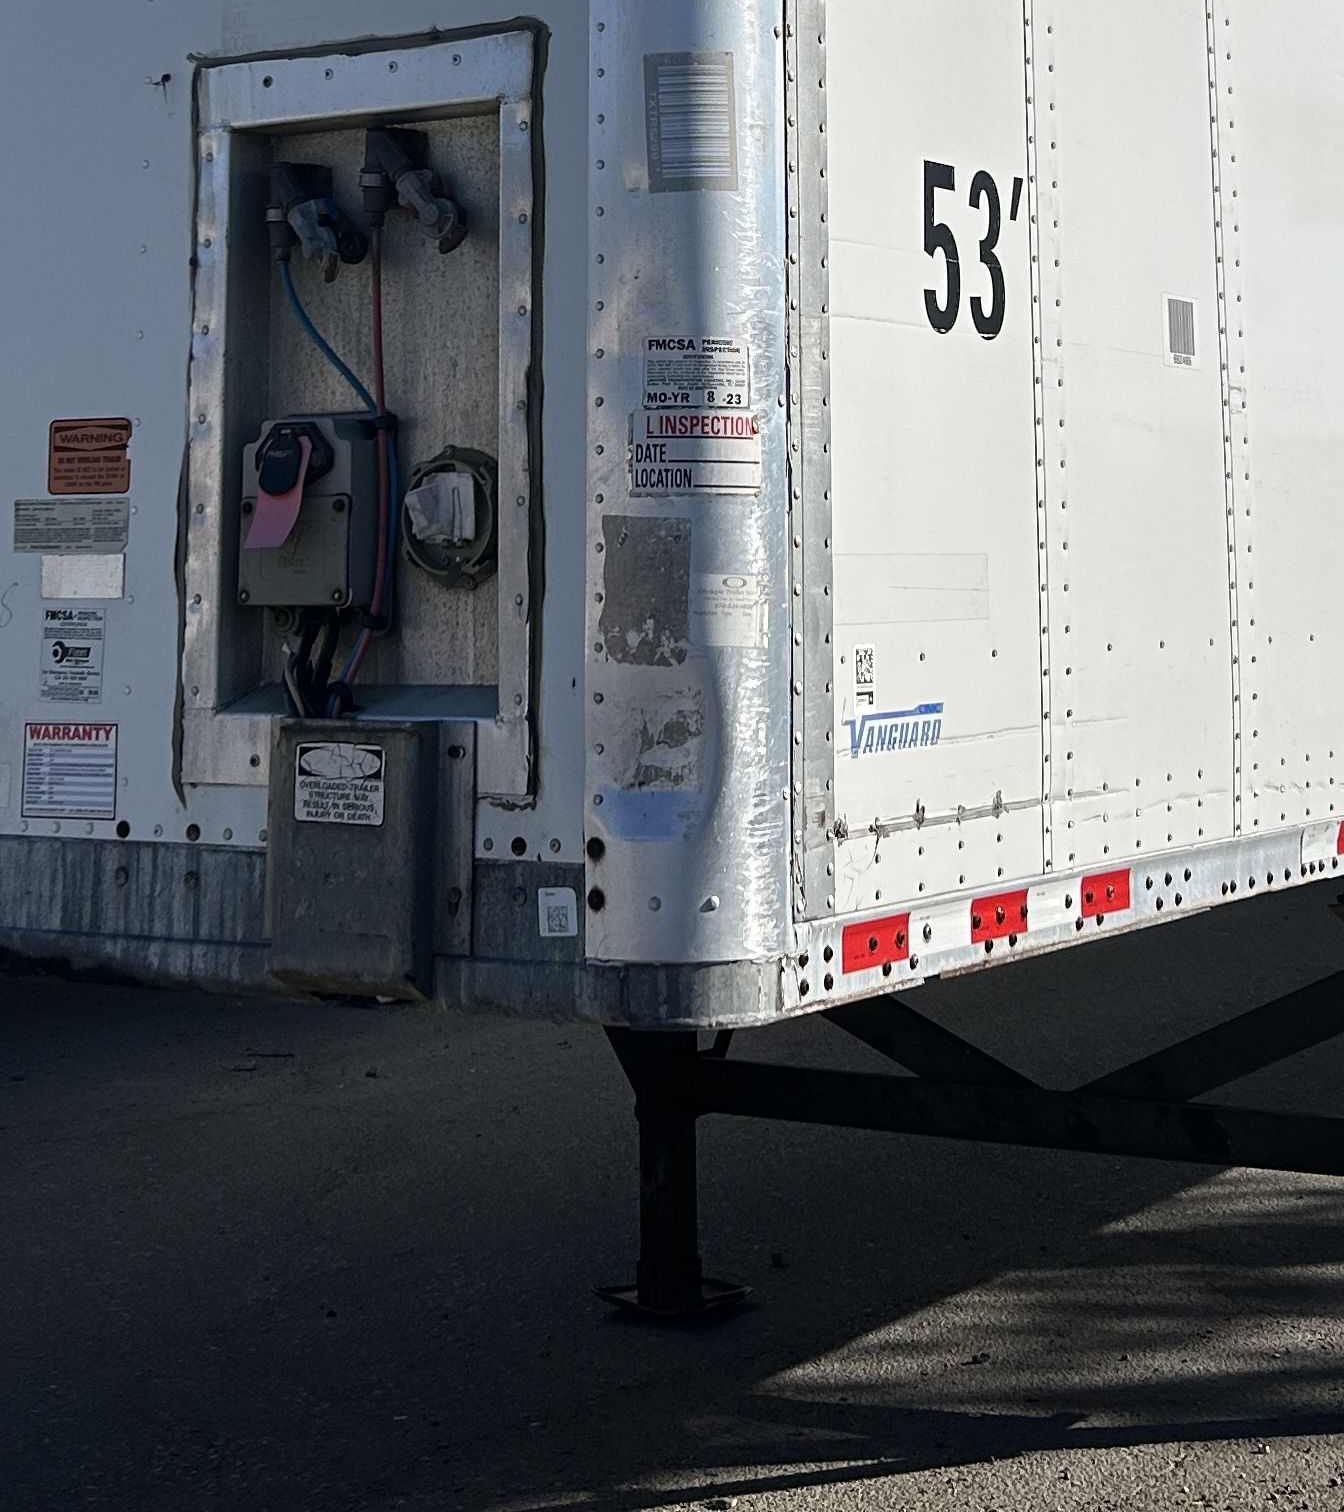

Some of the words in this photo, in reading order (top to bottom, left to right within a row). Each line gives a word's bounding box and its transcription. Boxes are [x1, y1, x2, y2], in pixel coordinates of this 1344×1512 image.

[923, 159, 1024, 341] 53'
[648, 339, 696, 351] FMCSA
[647, 392, 691, 403] MO-YR
[706, 390, 716, 403] 8
[659, 415, 757, 436] INSPECTION
[60, 432, 124, 444] WARNING
[635, 443, 667, 464] DATE
[635, 468, 692, 488] LOCATION
[29, 725, 113, 741] WARRANTY
[841, 715, 942, 759] VANGUARD
[308, 790, 351, 801] STRUCTURE
[347, 812, 371, 821] DEATH
